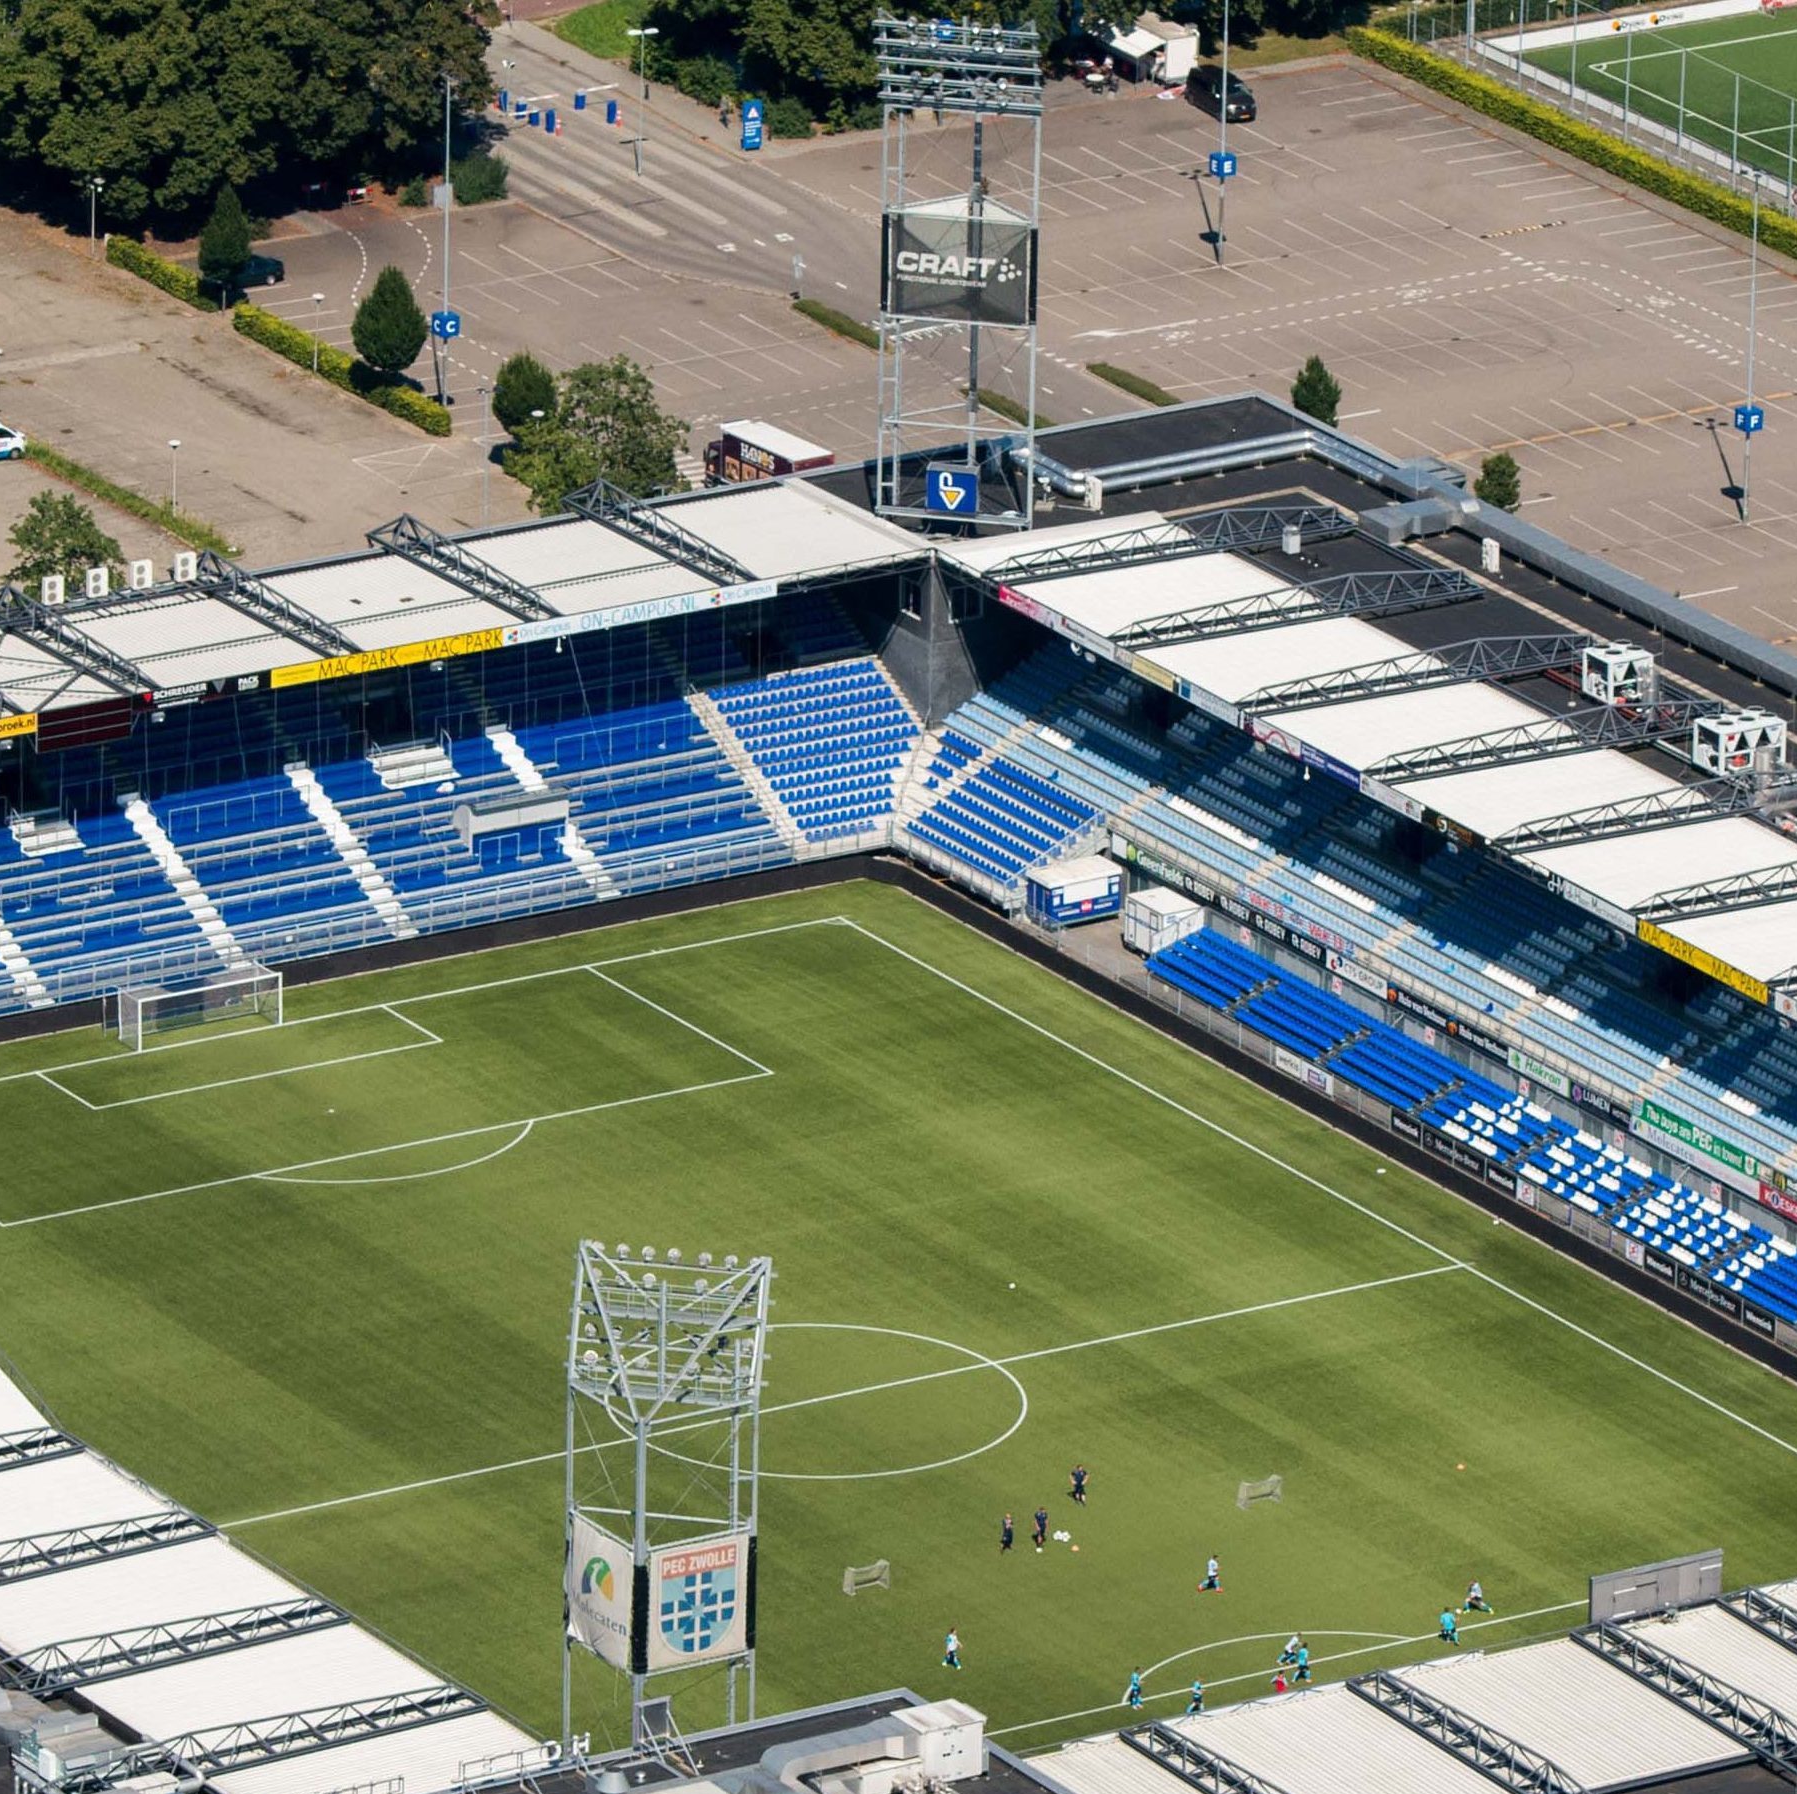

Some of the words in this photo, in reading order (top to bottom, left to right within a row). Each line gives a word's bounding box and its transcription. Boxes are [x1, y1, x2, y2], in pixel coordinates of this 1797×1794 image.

[896, 251, 996, 279] CRAFT
[153, 683, 207, 700] SCHREUDER
[1692, 1125, 1712, 1152] PEC
[662, 1560, 687, 1574] PEC
[689, 1547, 736, 1571] ZWOLLE
